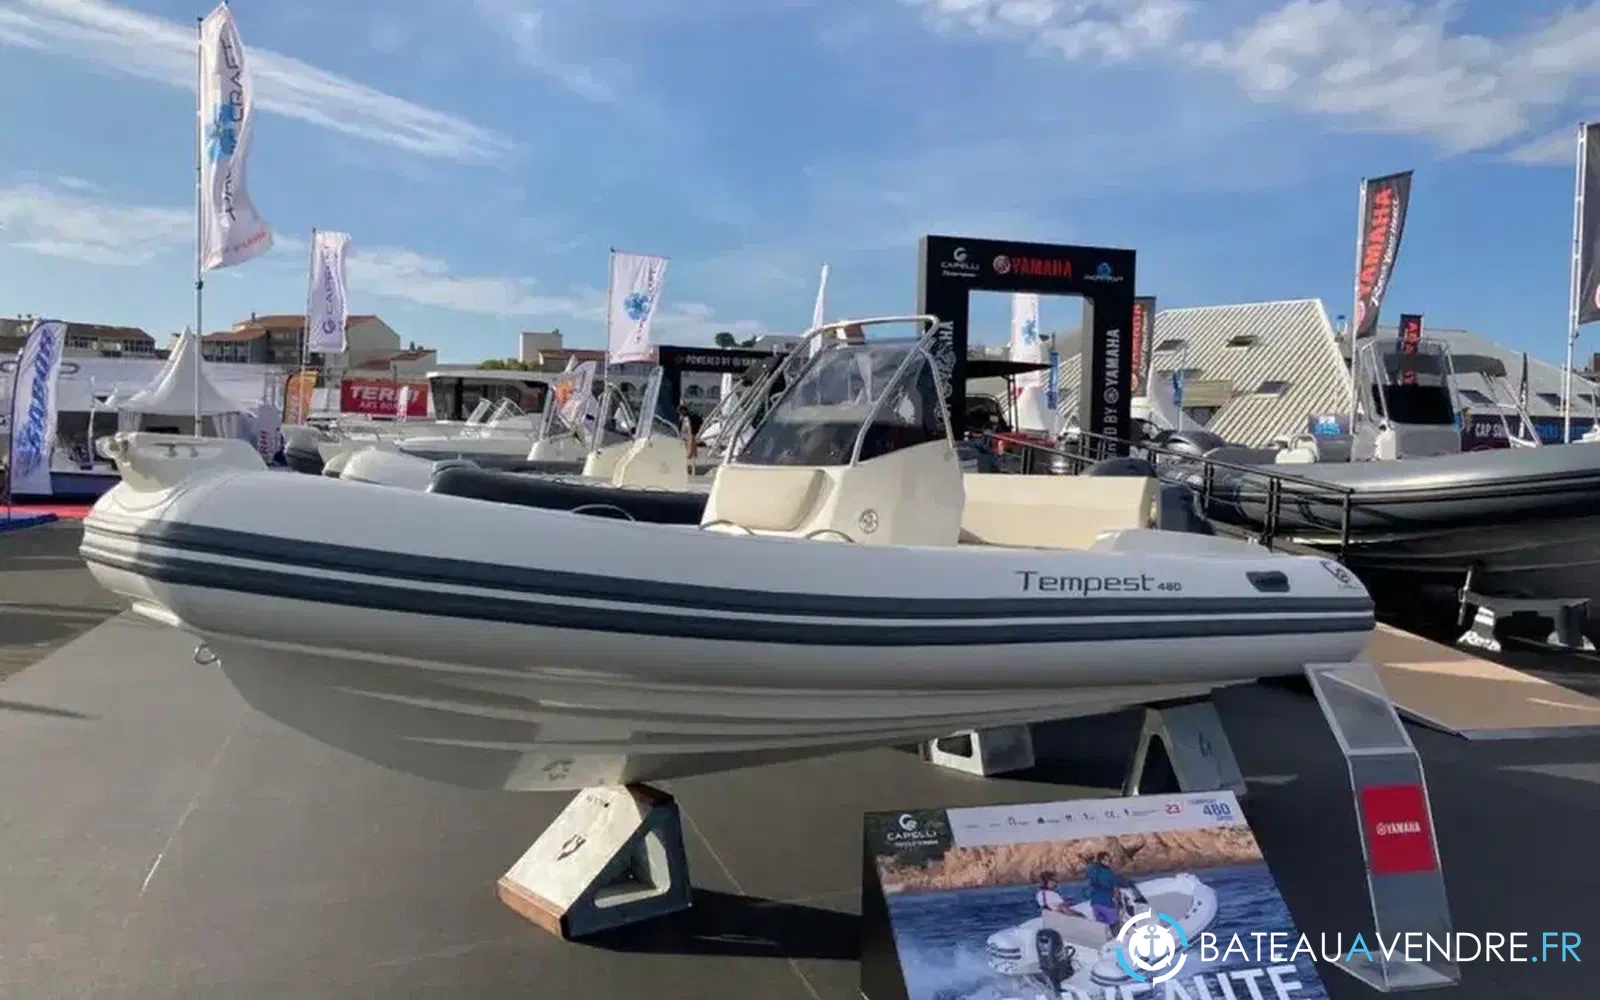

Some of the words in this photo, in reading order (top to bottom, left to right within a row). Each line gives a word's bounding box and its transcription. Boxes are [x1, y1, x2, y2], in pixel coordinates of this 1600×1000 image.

[1357, 184, 1393, 298] YAMAHA
[940, 261, 980, 271] CAPELLI
[1011, 256, 1073, 279] YAMAHA
[1105, 329, 1120, 386] YAMAHA
[1104, 407, 1118, 423] BY
[1475, 423, 1491, 437] CAP
[1015, 571, 1155, 596] Tempest
[1157, 582, 1182, 592] 480
[1165, 804, 1181, 815] 23
[1202, 803, 1232, 816] 480
[1387, 821, 1422, 835] YAMAHA
[886, 830, 938, 841] CAPELLI
